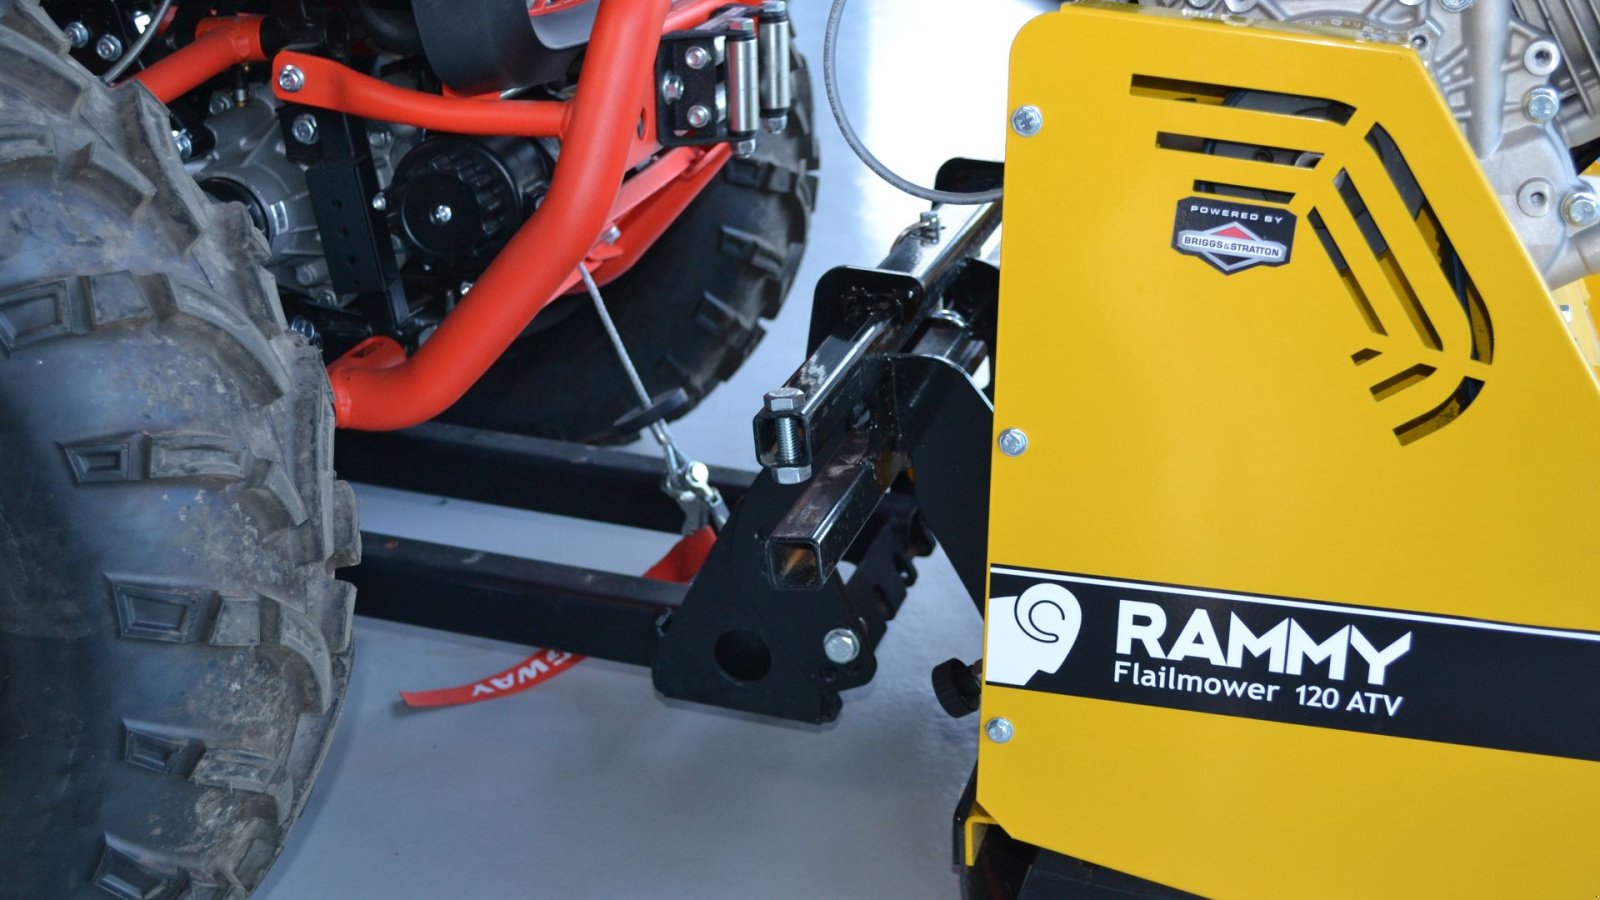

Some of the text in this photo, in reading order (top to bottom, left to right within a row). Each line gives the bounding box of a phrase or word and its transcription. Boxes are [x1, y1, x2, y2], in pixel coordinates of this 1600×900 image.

[1190, 205, 1284, 224] POWERED BY
[1184, 236, 1280, 257] BRIGGS&STRATTON
[1115, 599, 1412, 686] RAMMY
[1113, 660, 1404, 717] Flailmower 120 ATV
